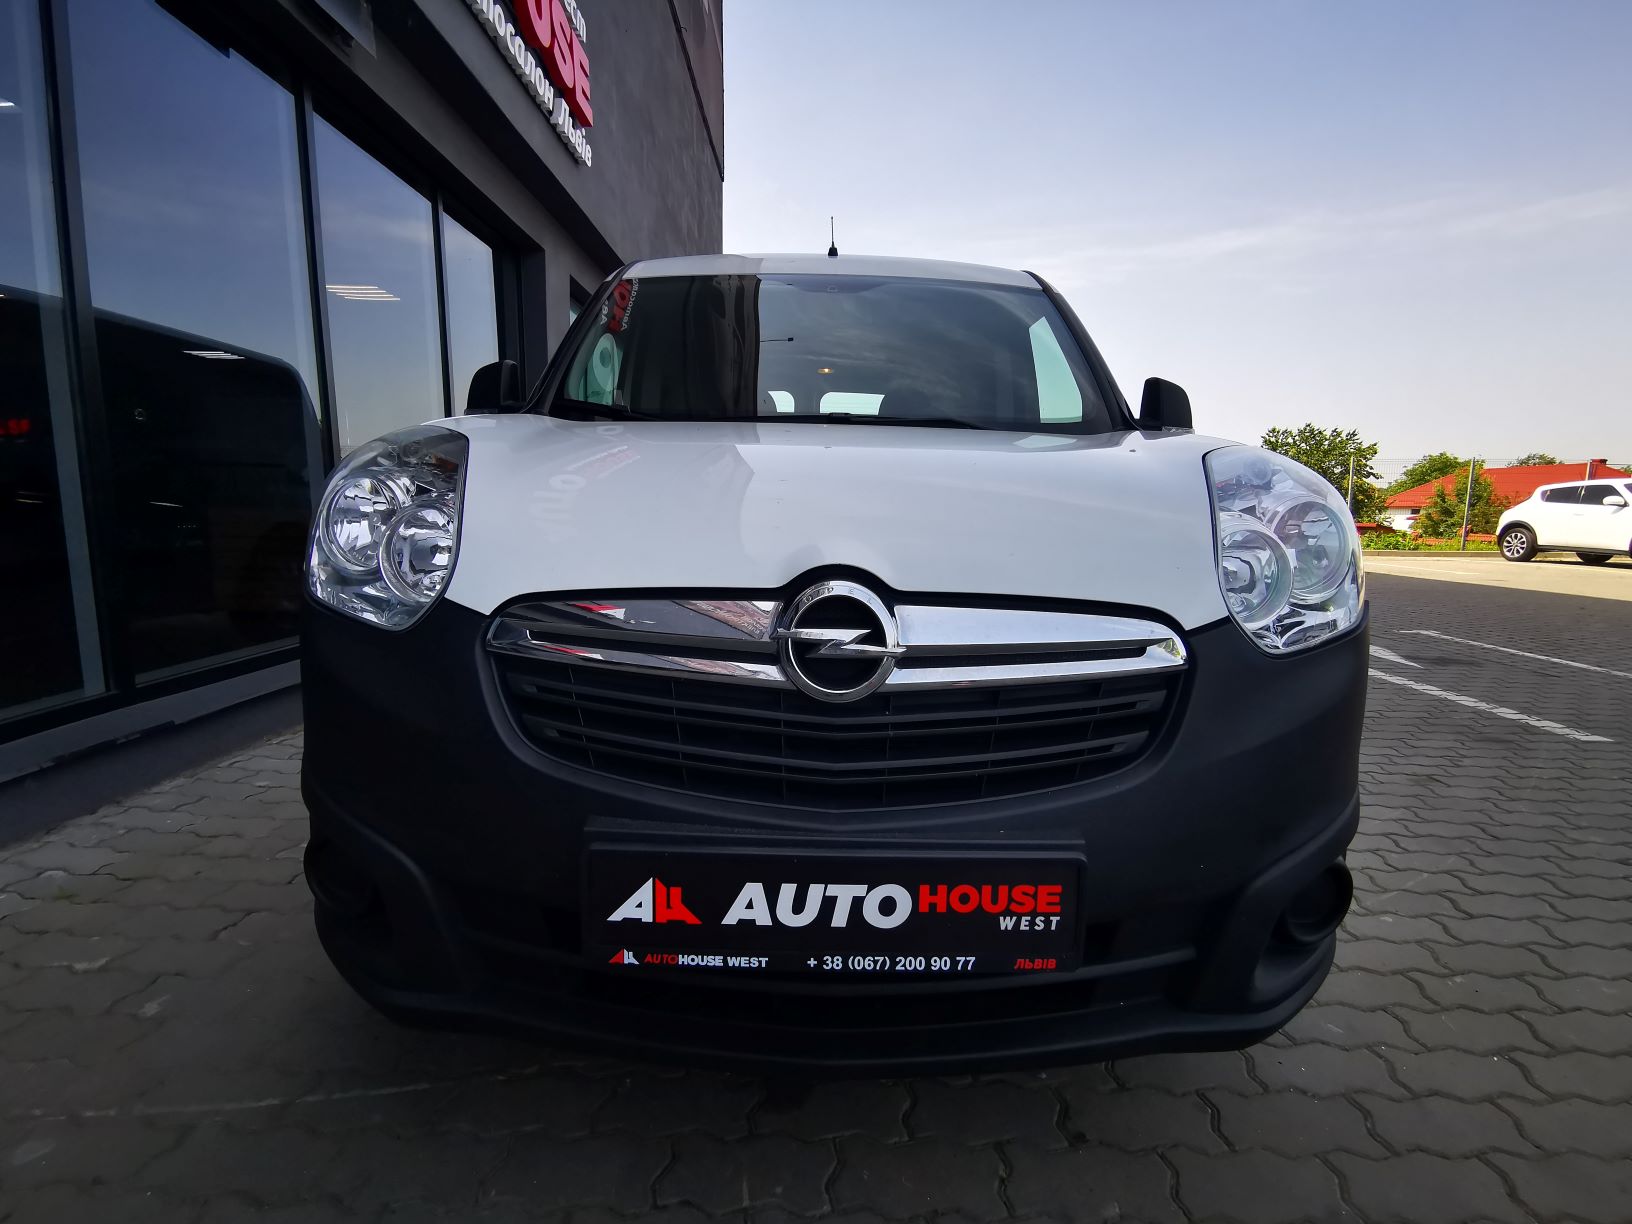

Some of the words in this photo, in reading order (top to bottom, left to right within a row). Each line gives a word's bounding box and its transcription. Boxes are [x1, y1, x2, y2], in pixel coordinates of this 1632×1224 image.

[556, 97, 592, 168] Львів
[721, 882, 913, 929] AUTO
[918, 884, 1062, 913] HOUSE
[999, 916, 1061, 931] WEST
[644, 953, 723, 967] AUTOHOUSE
[727, 956, 769, 968] WEST
[822, 956, 843, 970] 38
[848, 956, 890, 971] (067)
[895, 956, 926, 970] 200
[930, 956, 951, 970] 90
[955, 956, 976, 970] 77
